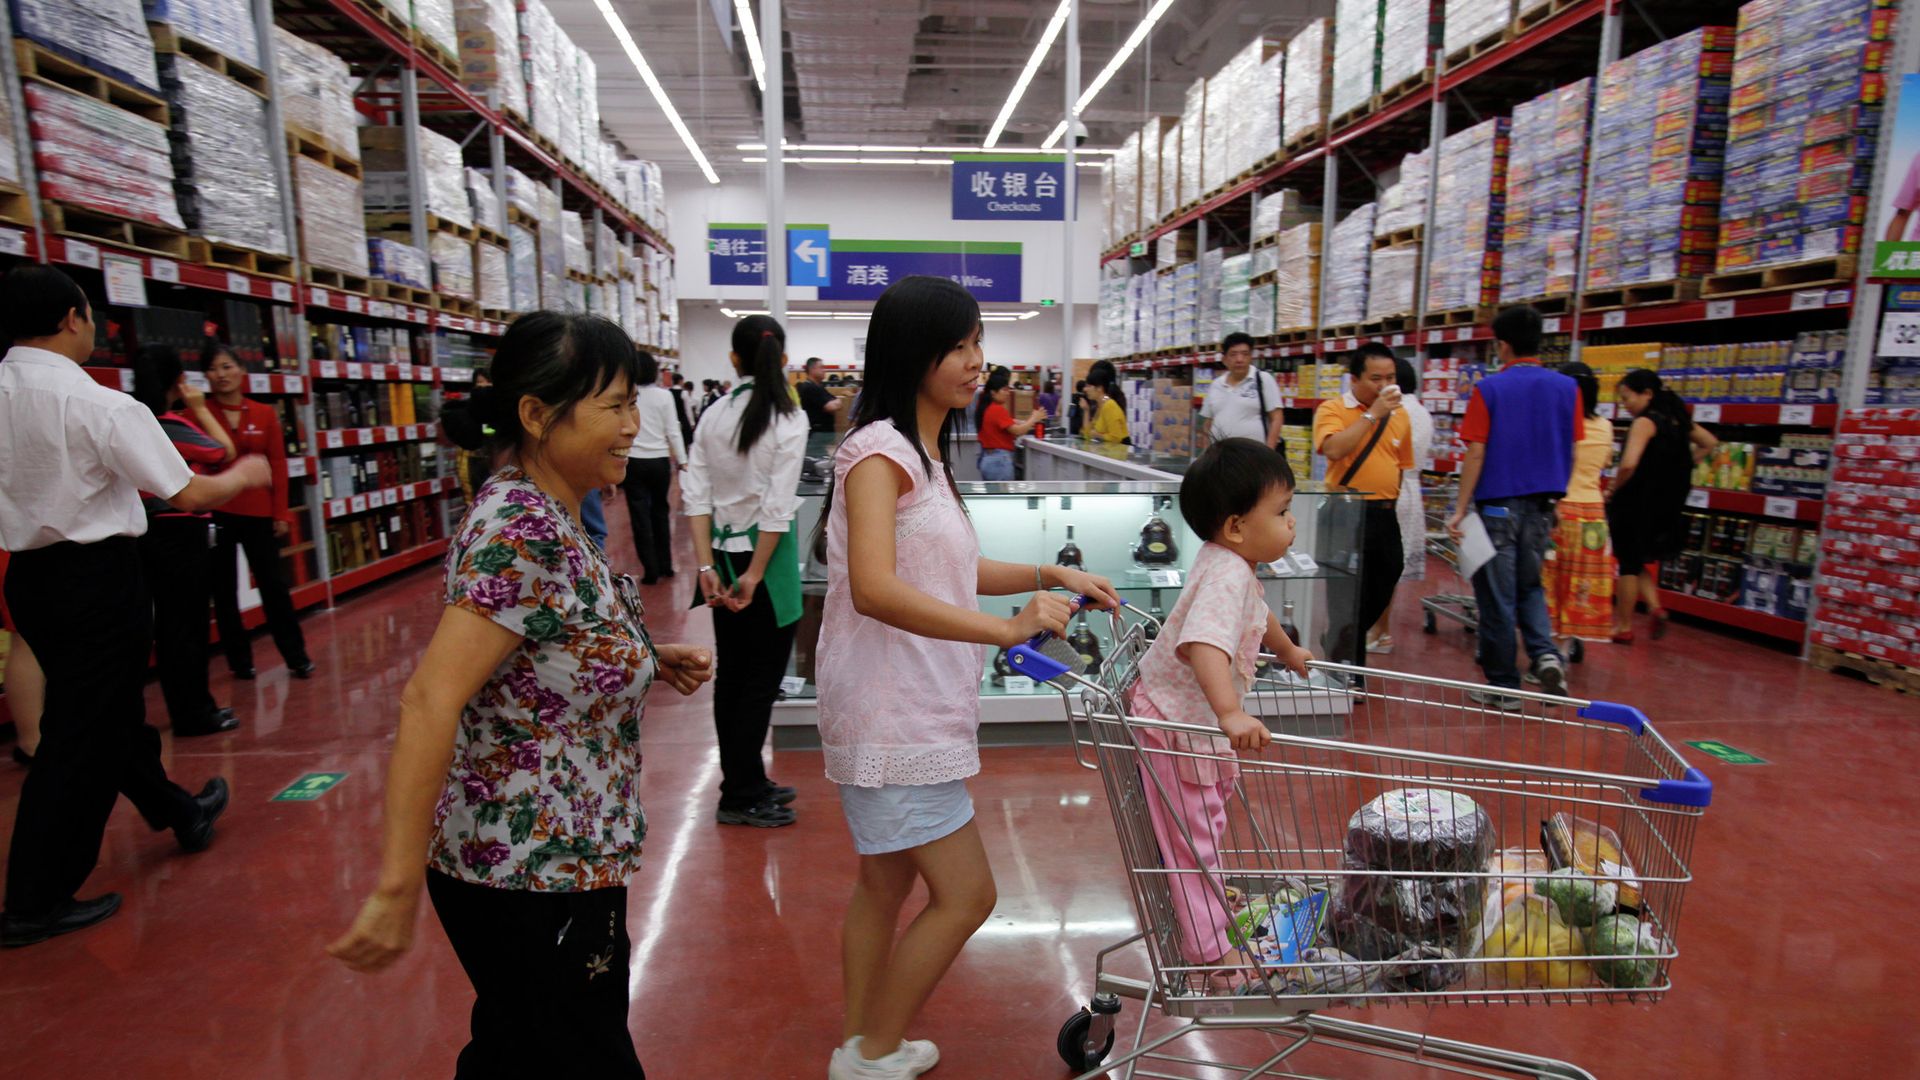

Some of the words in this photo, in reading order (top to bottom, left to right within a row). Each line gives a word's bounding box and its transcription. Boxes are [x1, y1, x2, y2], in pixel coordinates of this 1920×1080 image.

[971, 171, 1058, 198] 收银台
[987, 201, 1041, 212] Checkouts
[734, 262, 750, 273] To
[847, 264, 889, 286] 酒类
[961, 275, 994, 288] Wine
